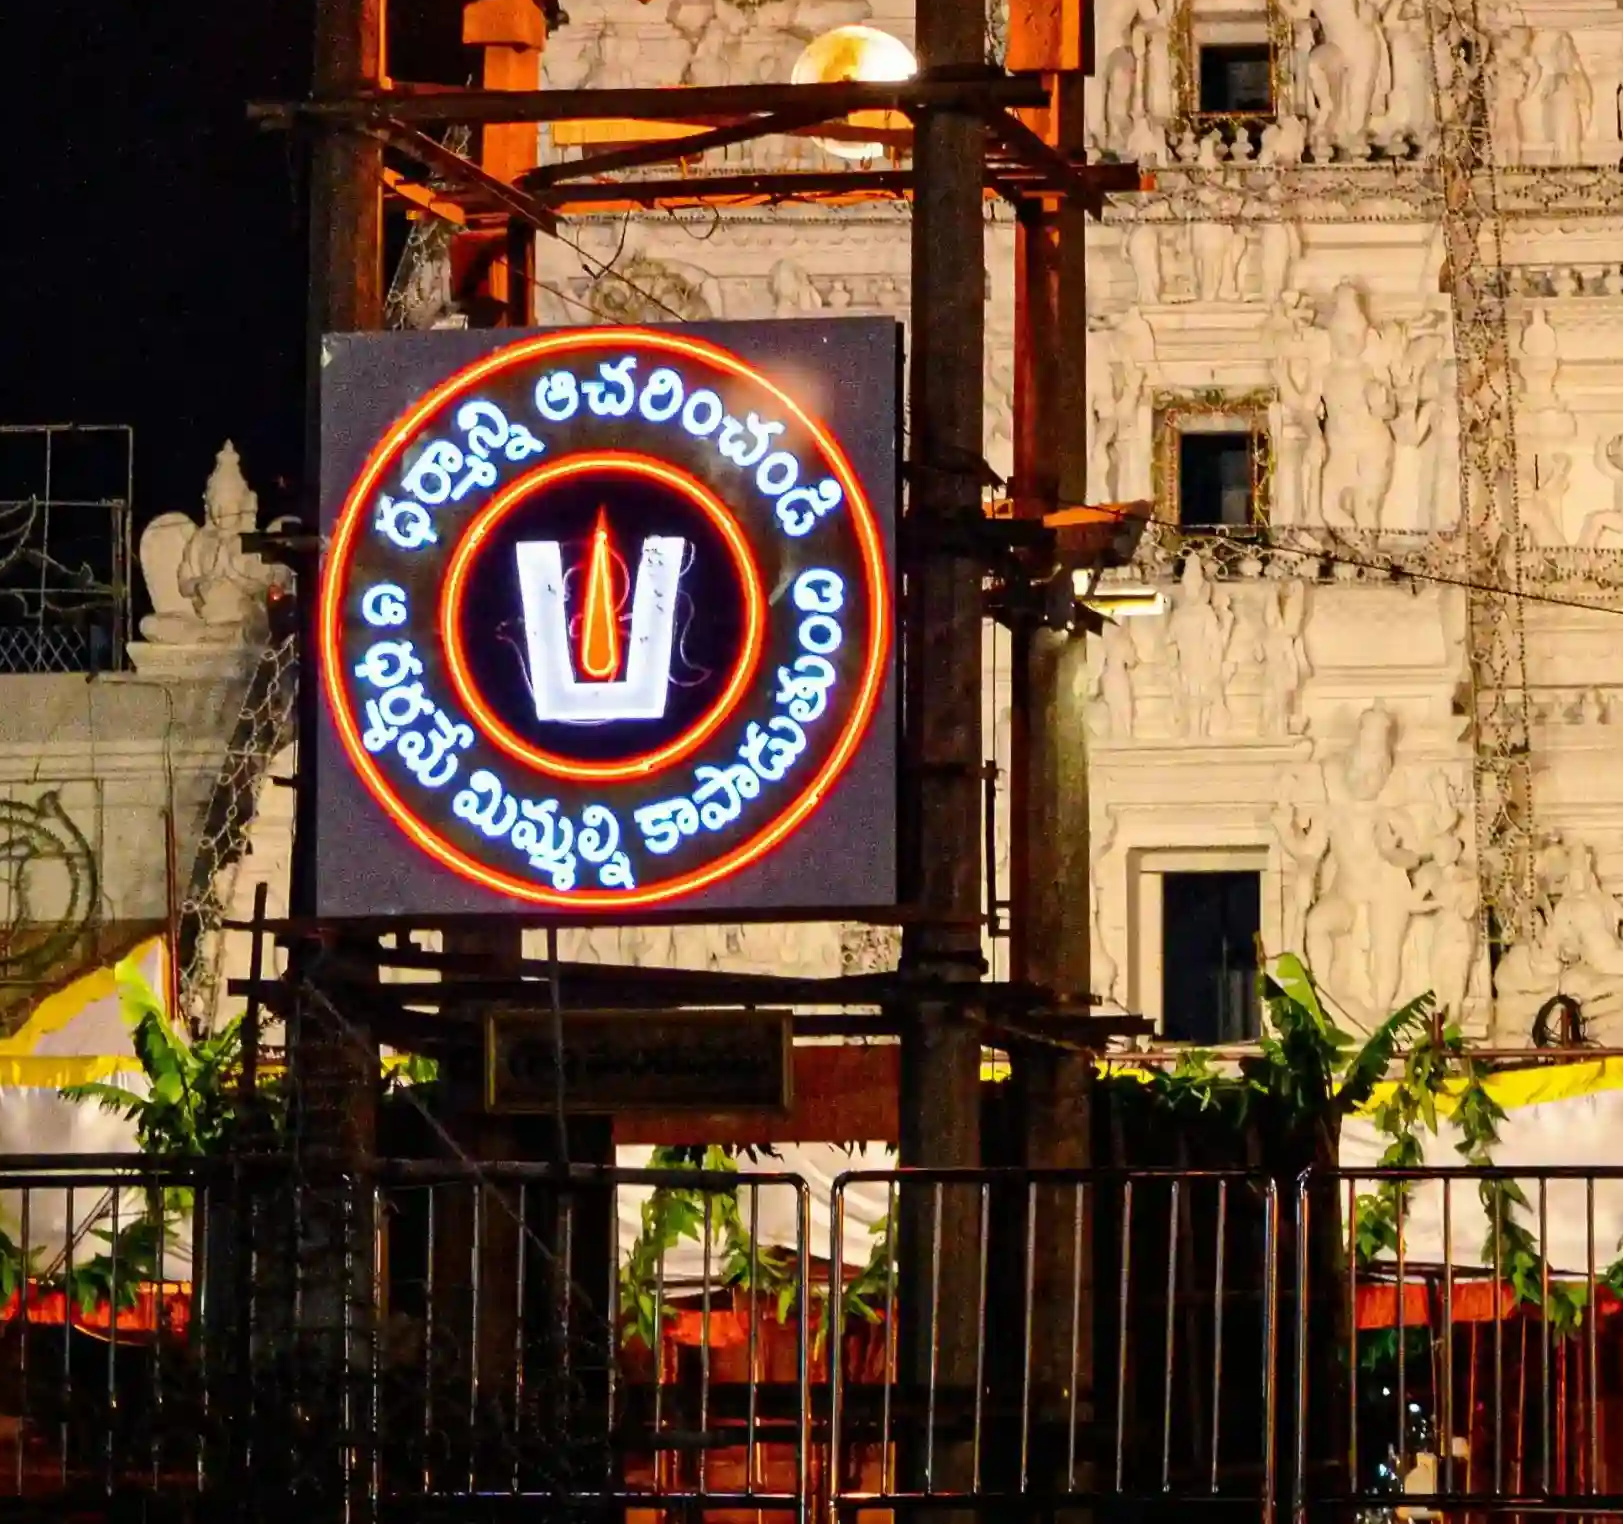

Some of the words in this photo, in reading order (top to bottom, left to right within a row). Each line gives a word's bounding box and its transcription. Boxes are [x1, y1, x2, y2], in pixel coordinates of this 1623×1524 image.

[375, 398, 545, 548] ధర్మాన్ని
[535, 356, 842, 536] ఆచరించండి
[362, 582, 407, 627] ఆ
[355, 639, 474, 787] ధర్మమే
[634, 568, 844, 854] కాపాడుతుంది
[453, 769, 635, 889] మిమ్మల్ని
